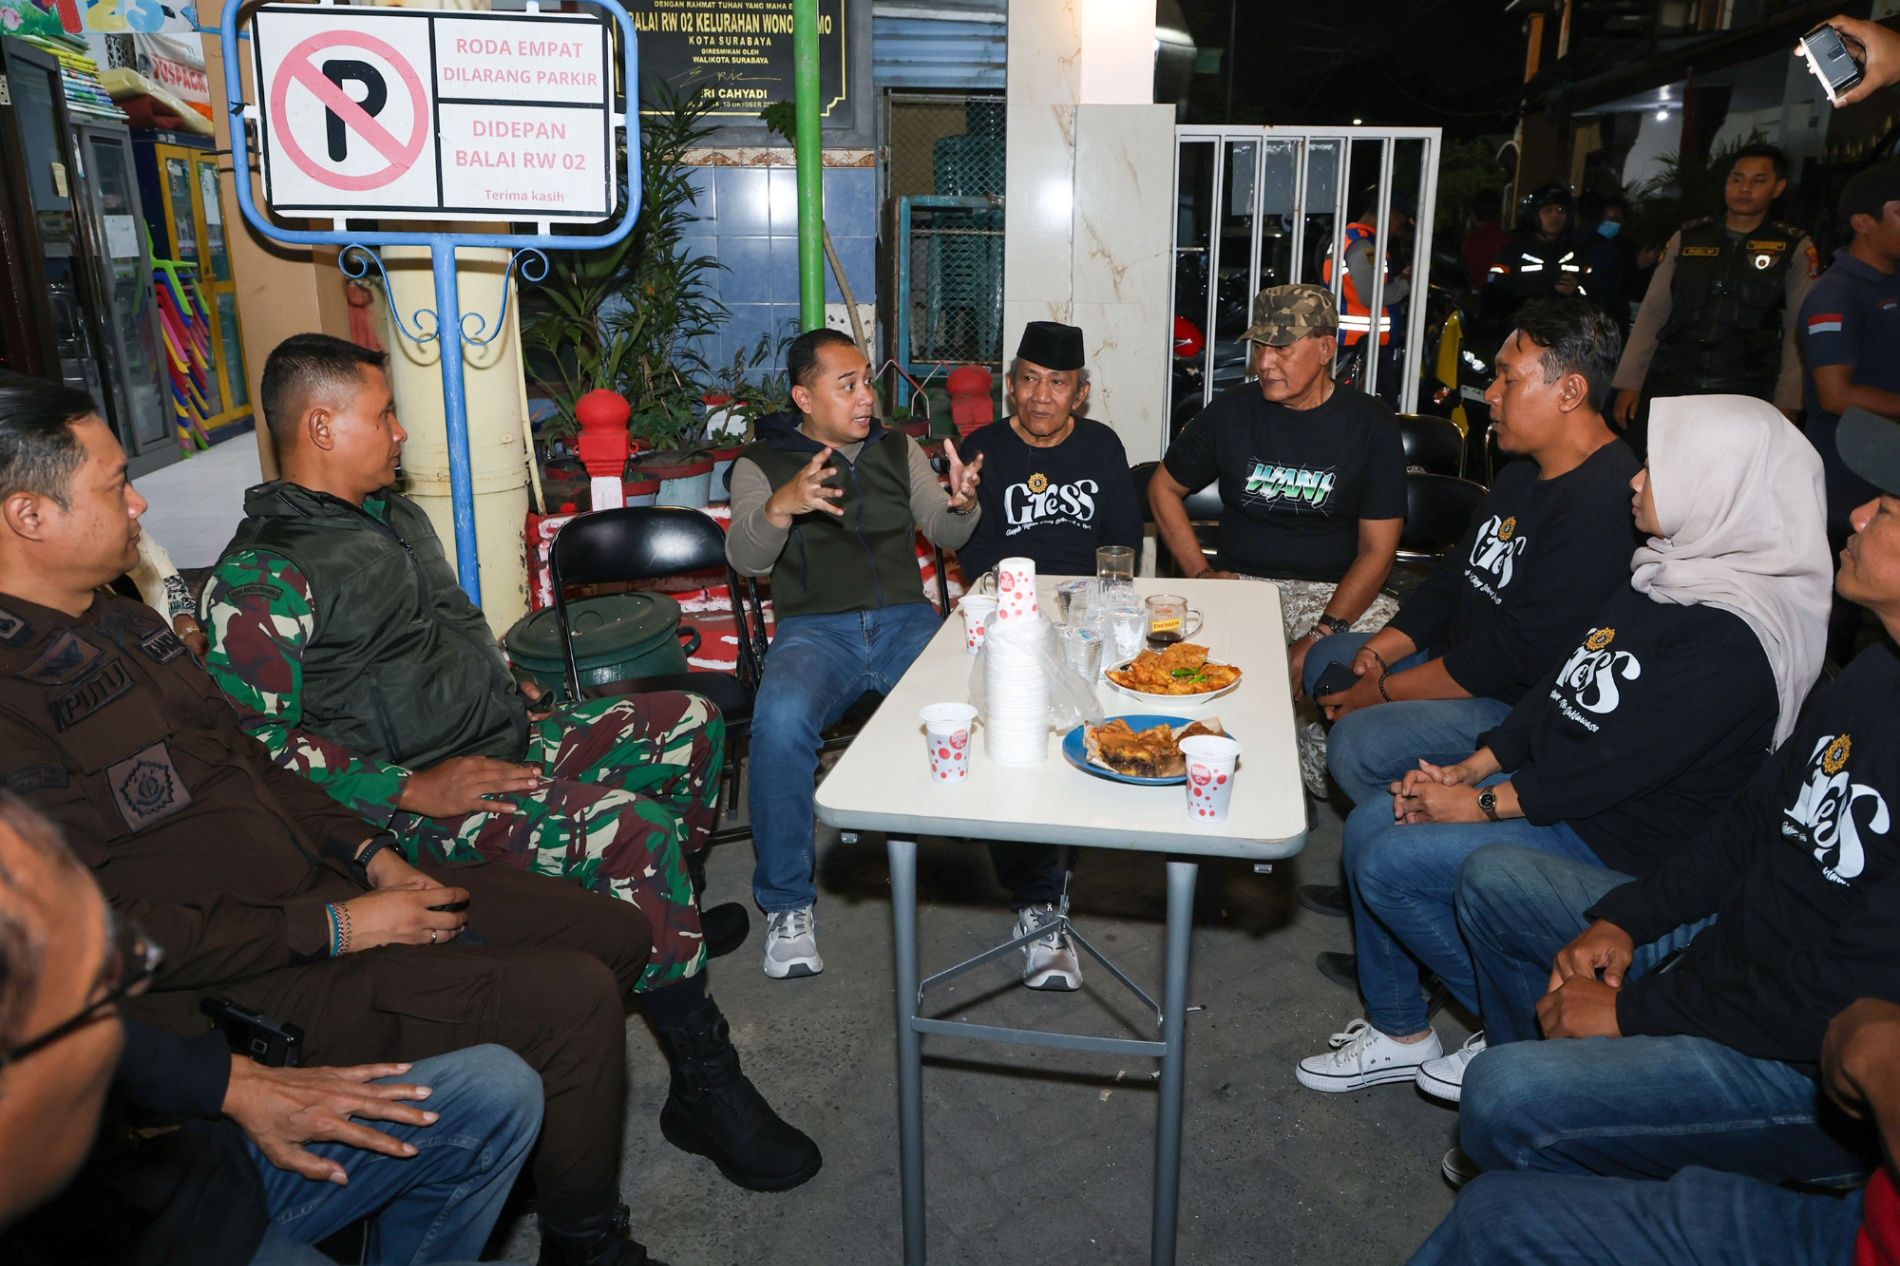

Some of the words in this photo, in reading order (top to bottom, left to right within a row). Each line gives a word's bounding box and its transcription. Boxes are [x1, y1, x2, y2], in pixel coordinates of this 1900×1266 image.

[687, 1, 716, 9] RAHMAT
[718, 1, 743, 9] TUHAN
[745, 2, 765, 10] YANG
[661, 12, 678, 32] RW
[680, 13, 693, 32] 02
[695, 13, 759, 33] KELURAHAN
[456, 38, 512, 55] RODA
[518, 40, 583, 58] EMPAT
[688, 36, 715, 46] KOTA
[719, 36, 772, 46] SURABAYA
[692, 56, 730, 64] WALIKOTA
[731, 57, 769, 65] SURABAYA
[444, 67, 531, 83] DILARANG
[537, 70, 597, 86] PARKIR
[718, 88, 768, 99] CAHYADI
[473, 120, 566, 140] DIDEPAN
[456, 150, 516, 168] BALAI
[523, 152, 556, 169] RW
[562, 153, 586, 170] 02
[485, 190, 528, 201] Terima
[531, 191, 564, 202] kasih
[65, 662, 125, 719] PUTU
